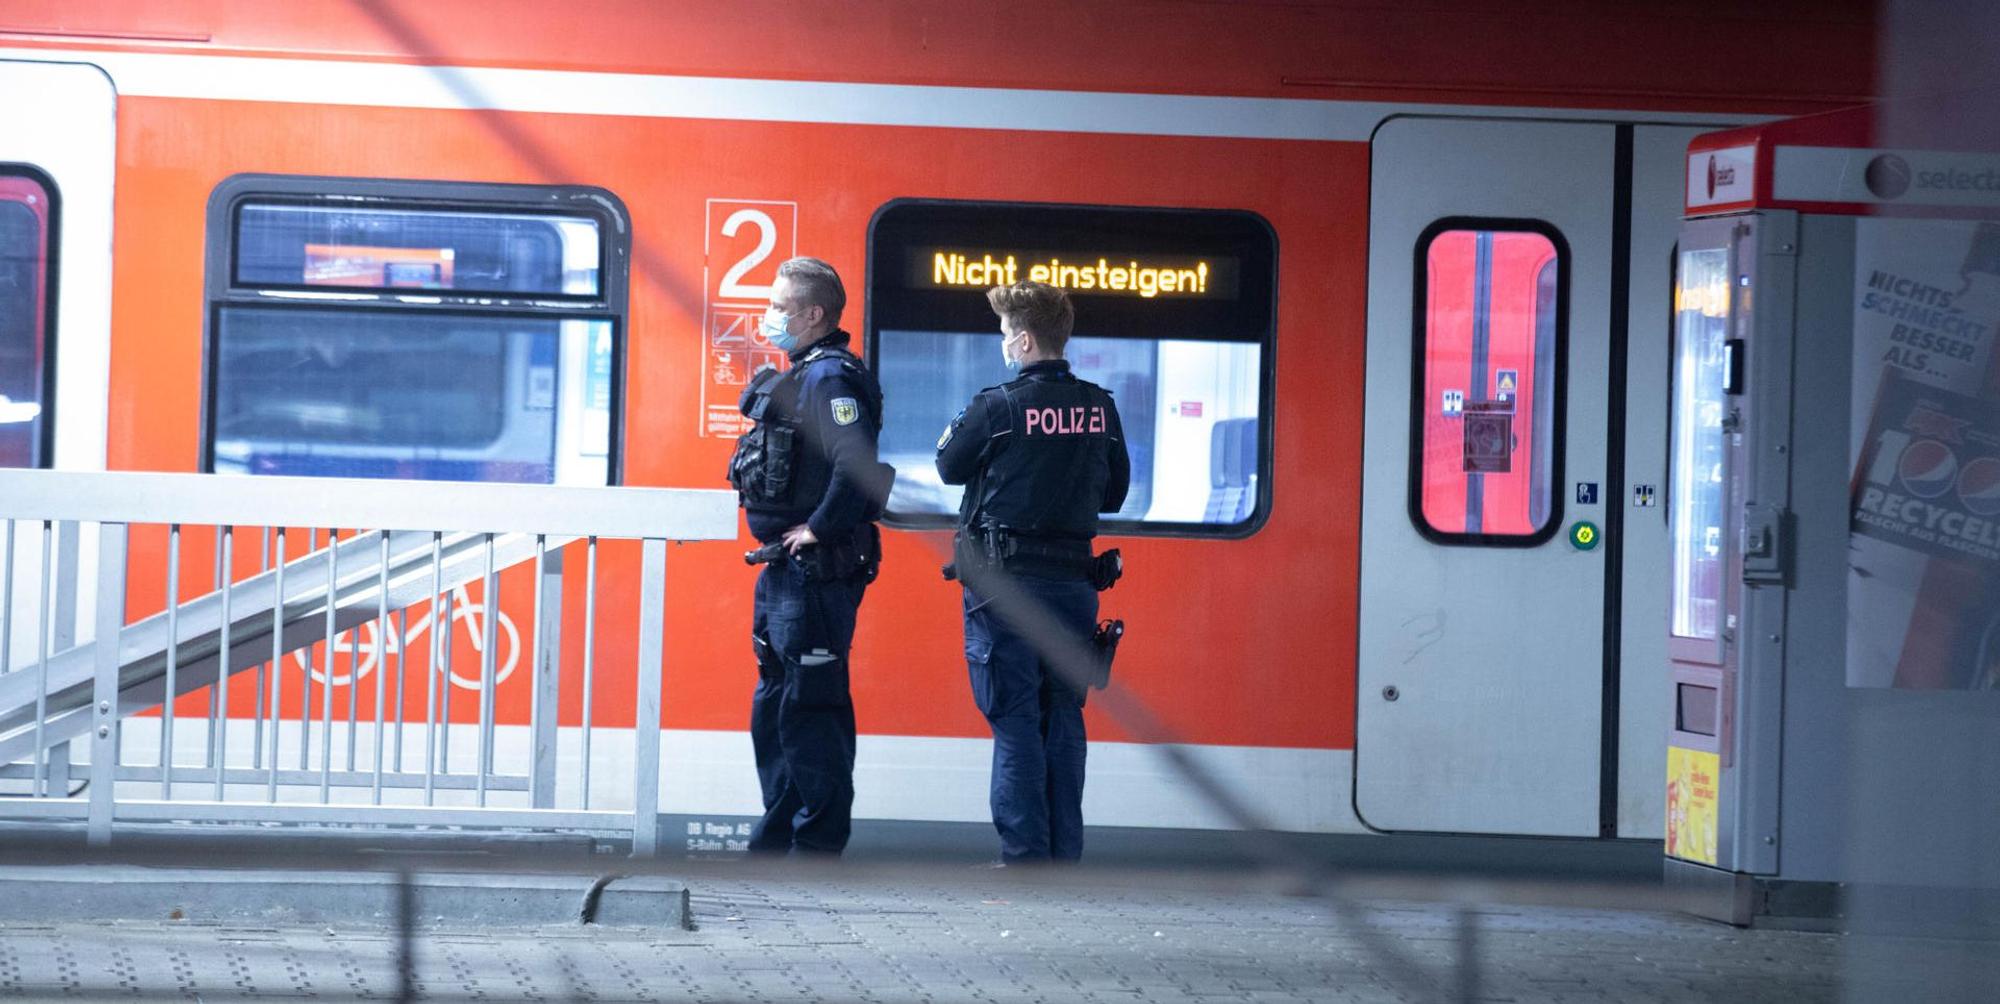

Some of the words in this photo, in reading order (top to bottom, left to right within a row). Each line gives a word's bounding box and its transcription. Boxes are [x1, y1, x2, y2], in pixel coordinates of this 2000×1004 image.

[1917, 168, 2000, 191] select
[719, 208, 778, 299] 2
[933, 252, 1018, 285] Nicht
[1030, 258, 1208, 297] einsteigen!
[1861, 291, 1988, 341] SCHMECKT
[1890, 323, 1976, 362] BESSER
[1025, 406, 1106, 435] POLIZEI
[1860, 486, 2000, 550] RECYCEL
